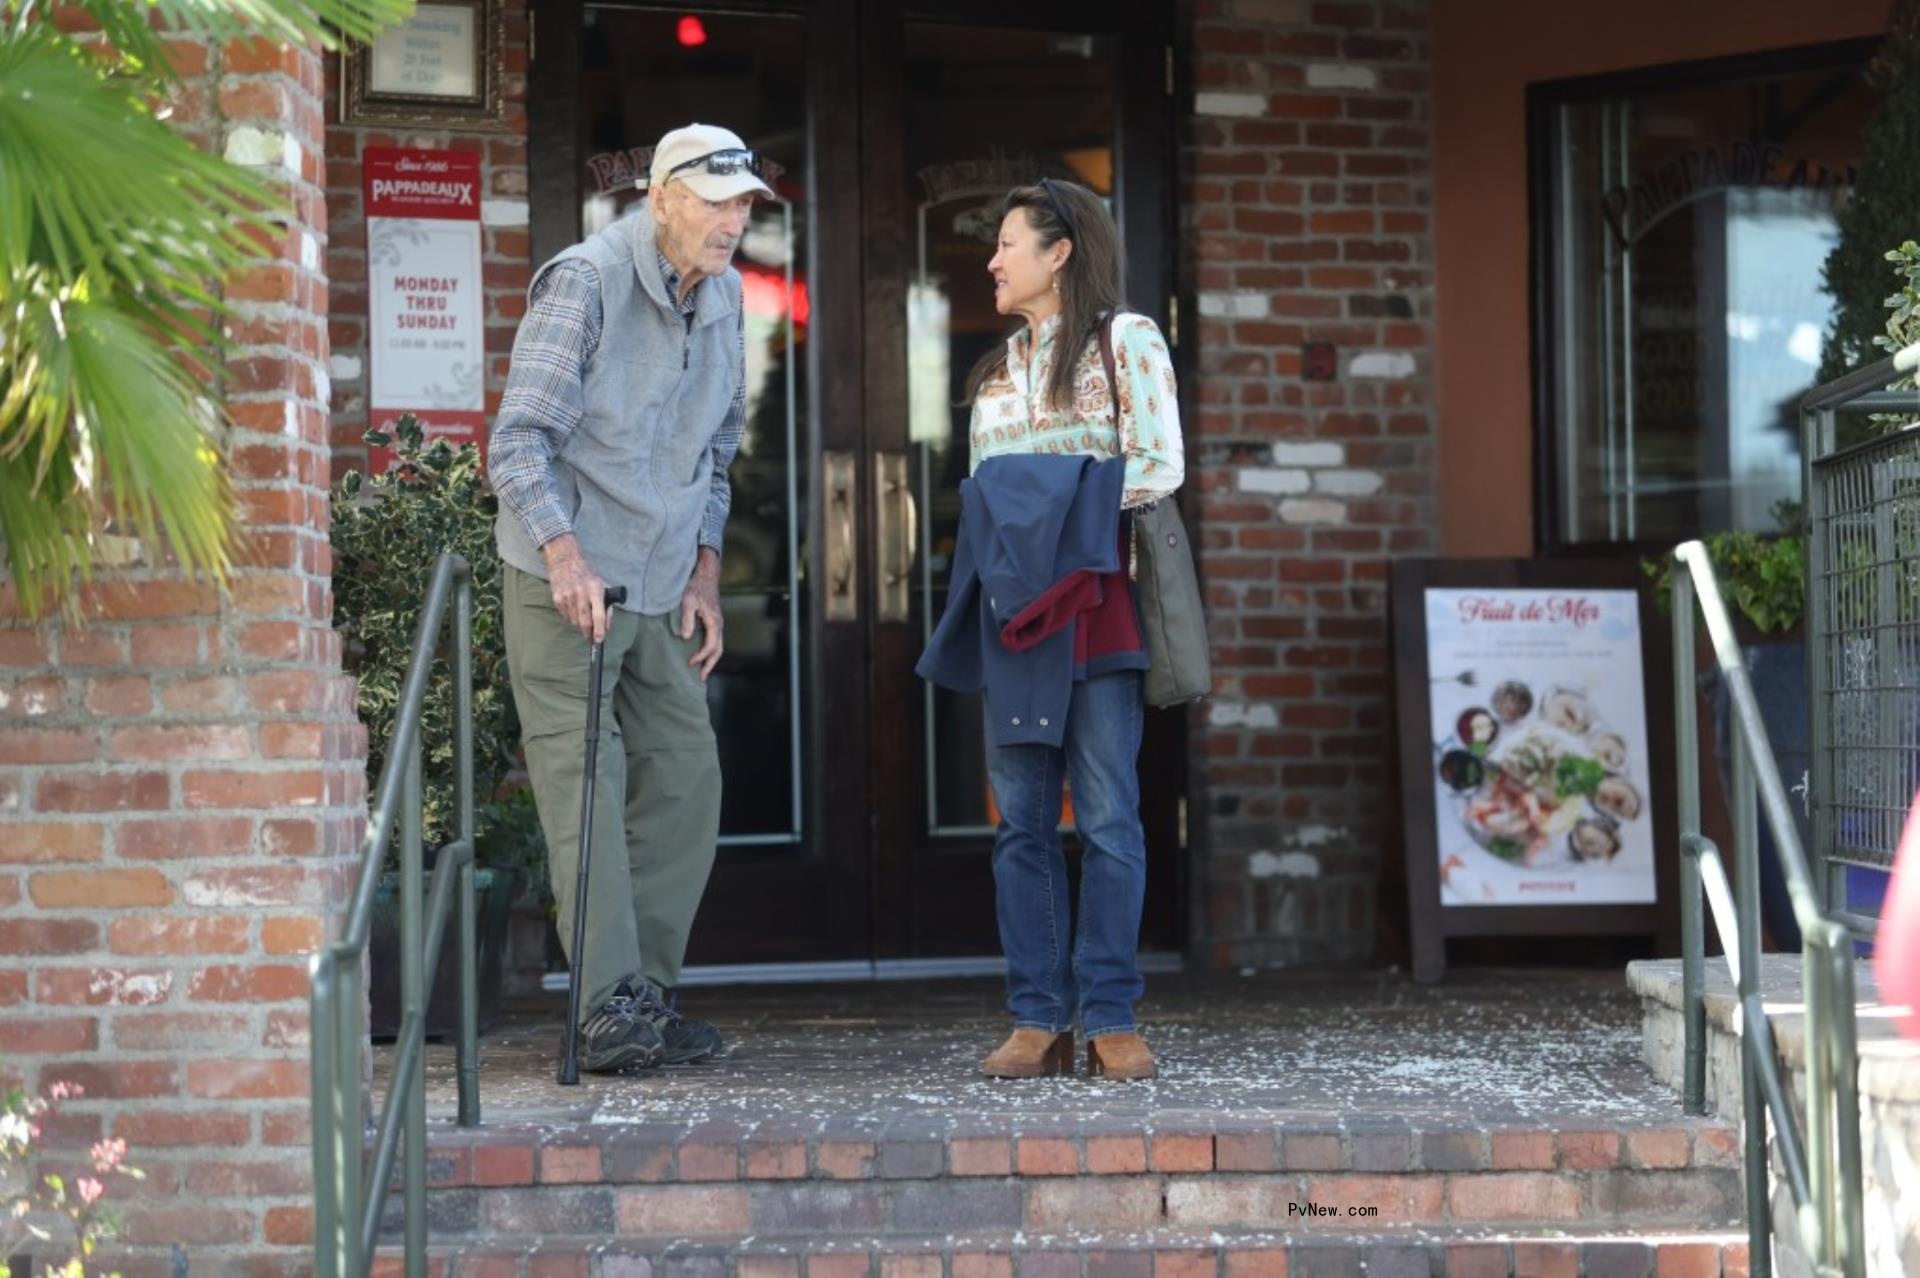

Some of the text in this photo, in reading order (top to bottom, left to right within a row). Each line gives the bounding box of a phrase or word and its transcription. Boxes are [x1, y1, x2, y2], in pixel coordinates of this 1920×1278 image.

[372, 179, 473, 206] PAPPADEAUX
[394, 276, 459, 292] MONDAY
[406, 296, 447, 310] THRU
[396, 315, 457, 330] SUNDAY
[1519, 598, 1543, 621] de
[1546, 595, 1601, 629] Mer
